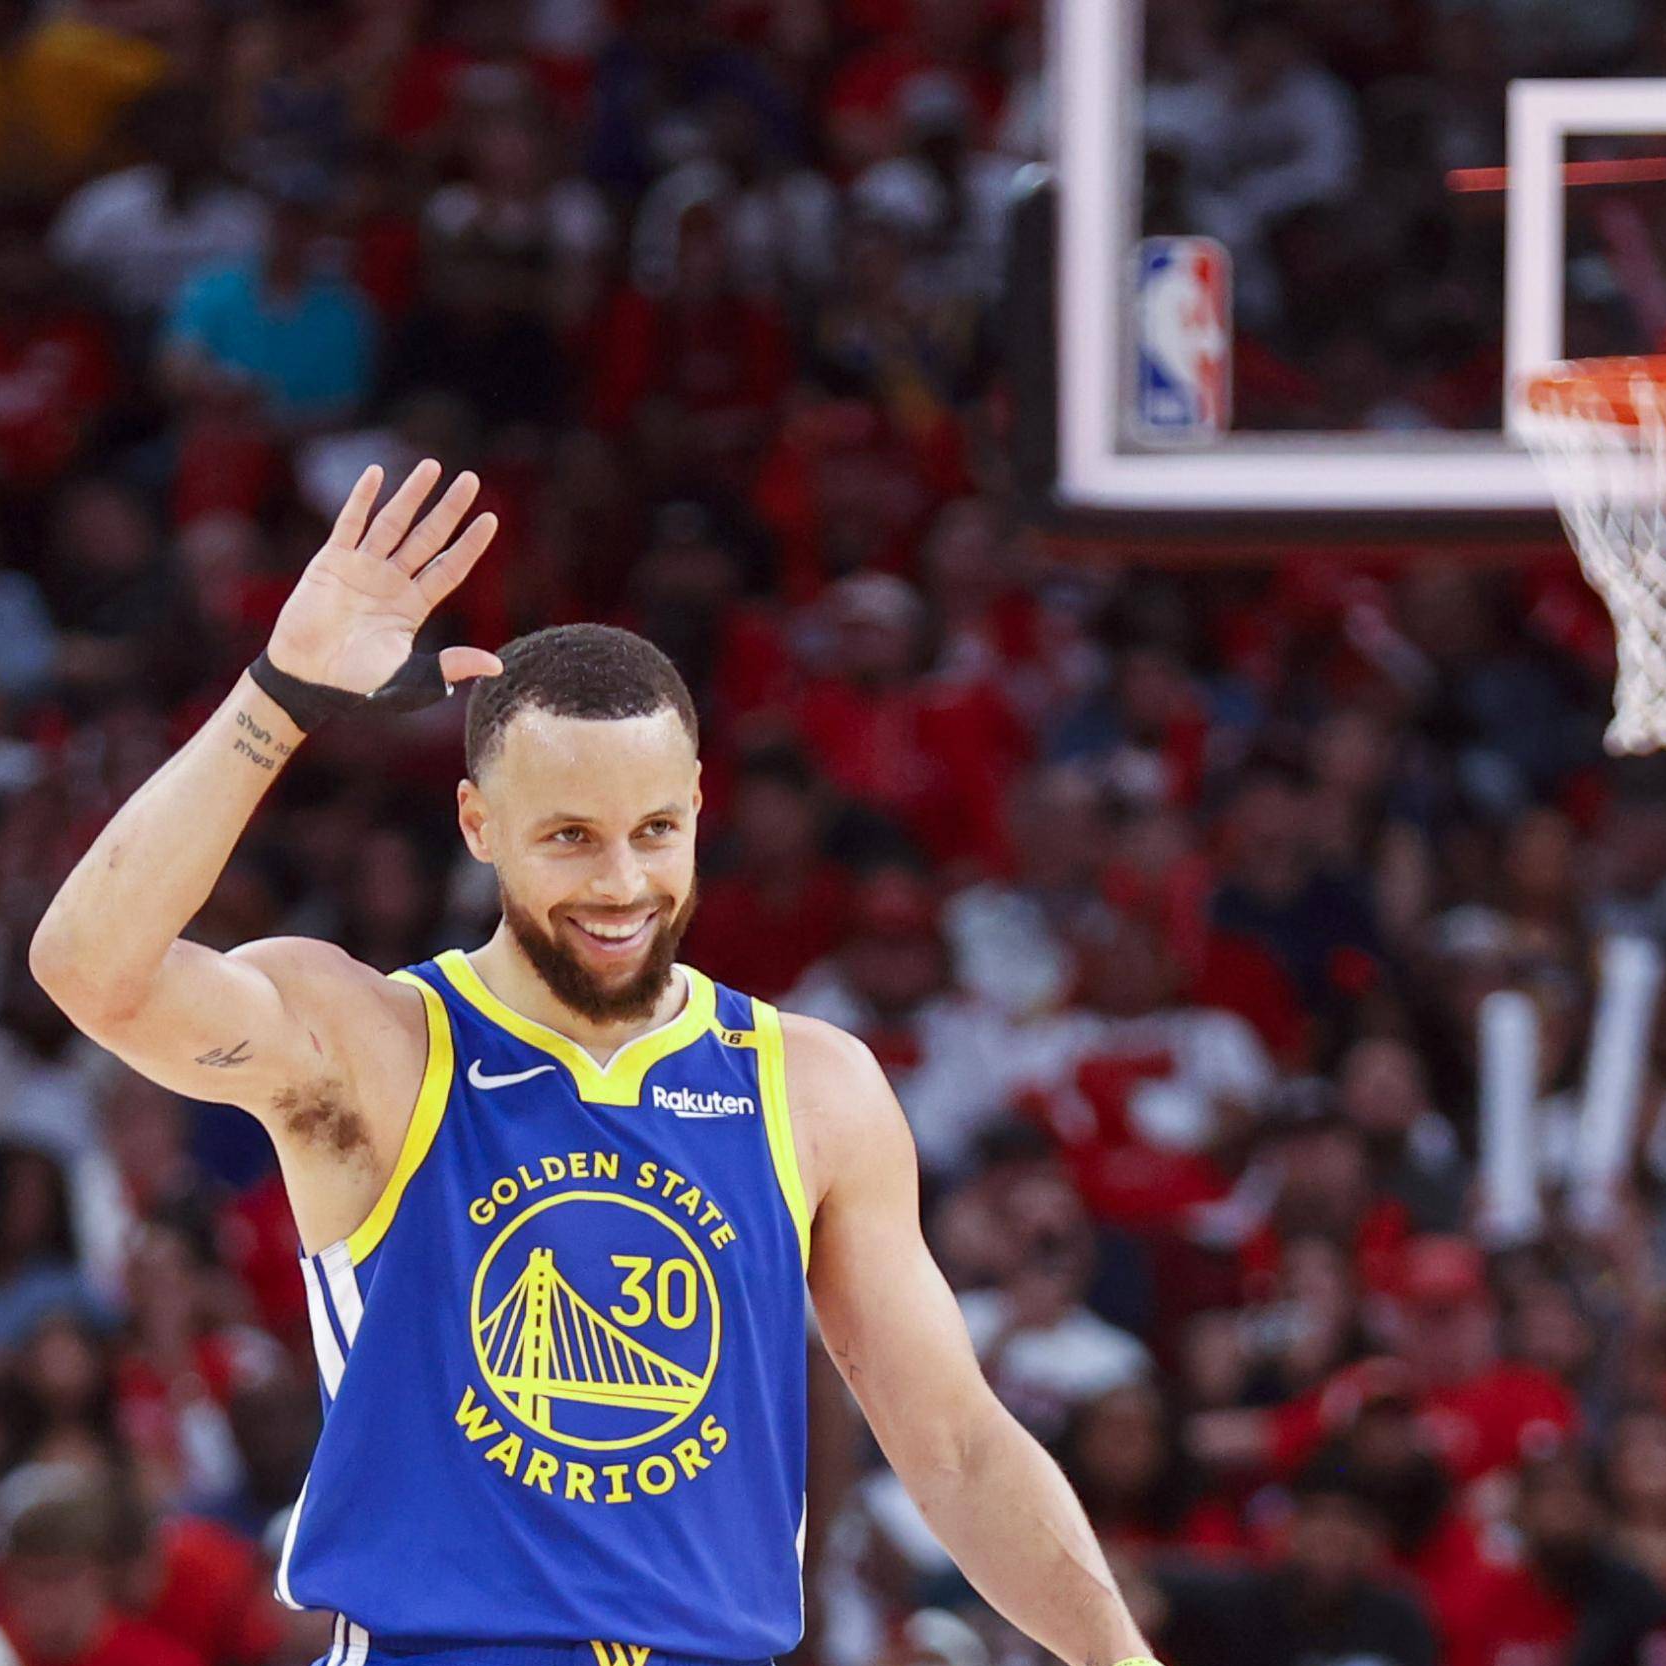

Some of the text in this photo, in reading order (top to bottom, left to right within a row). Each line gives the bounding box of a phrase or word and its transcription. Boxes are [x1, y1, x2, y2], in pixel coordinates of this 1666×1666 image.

[652, 1085, 755, 1118] Rakuten
[468, 1151, 737, 1251] GOLDEN STATE
[609, 1253, 699, 1331] 30
[454, 1384, 728, 1504] WARRIORS
